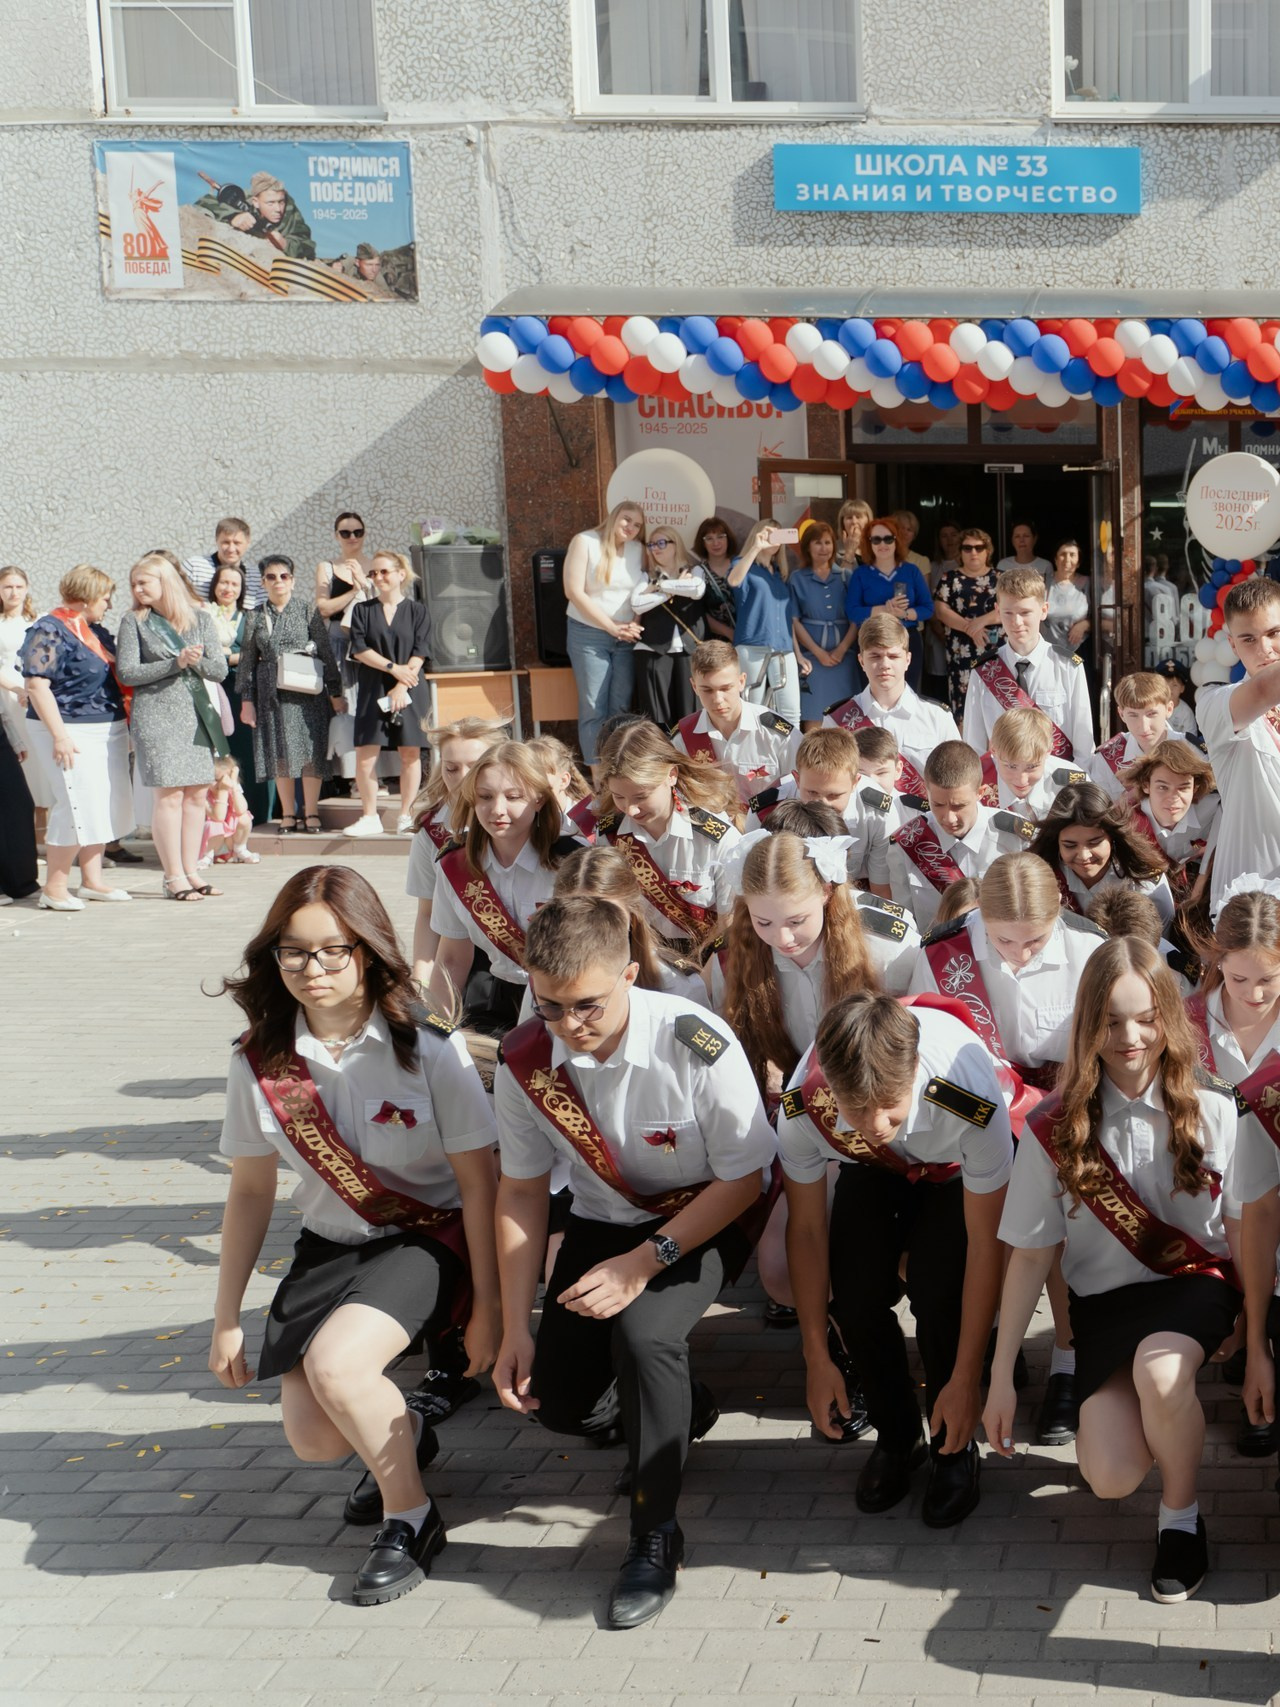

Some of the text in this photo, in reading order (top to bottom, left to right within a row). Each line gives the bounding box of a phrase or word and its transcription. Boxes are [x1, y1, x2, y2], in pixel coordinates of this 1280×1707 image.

[308, 156, 400, 179] ГОРДИМСЯ
[854, 153, 1048, 178] ШКОЛА № 33
[309, 180, 394, 206] ПОБЕДОЙ!
[796, 184, 1118, 204] ЗНАНИЯ И ТВОРЧЕСТВО
[123, 233, 148, 258] 80
[124, 262, 171, 275] ПОБЕДА!
[644, 486, 667, 501] Год
[1200, 485, 1270, 503] Последний
[1212, 502, 1257, 514] звонок
[880, 793, 893, 812] 33
[702, 817, 719, 835] КК
[711, 822, 729, 842] 33
[890, 920, 907, 939] 33
[691, 1027, 713, 1049] КК
[703, 1037, 724, 1058] 33
[783, 1094, 797, 1115] КК
[973, 1103, 992, 1124] КК
